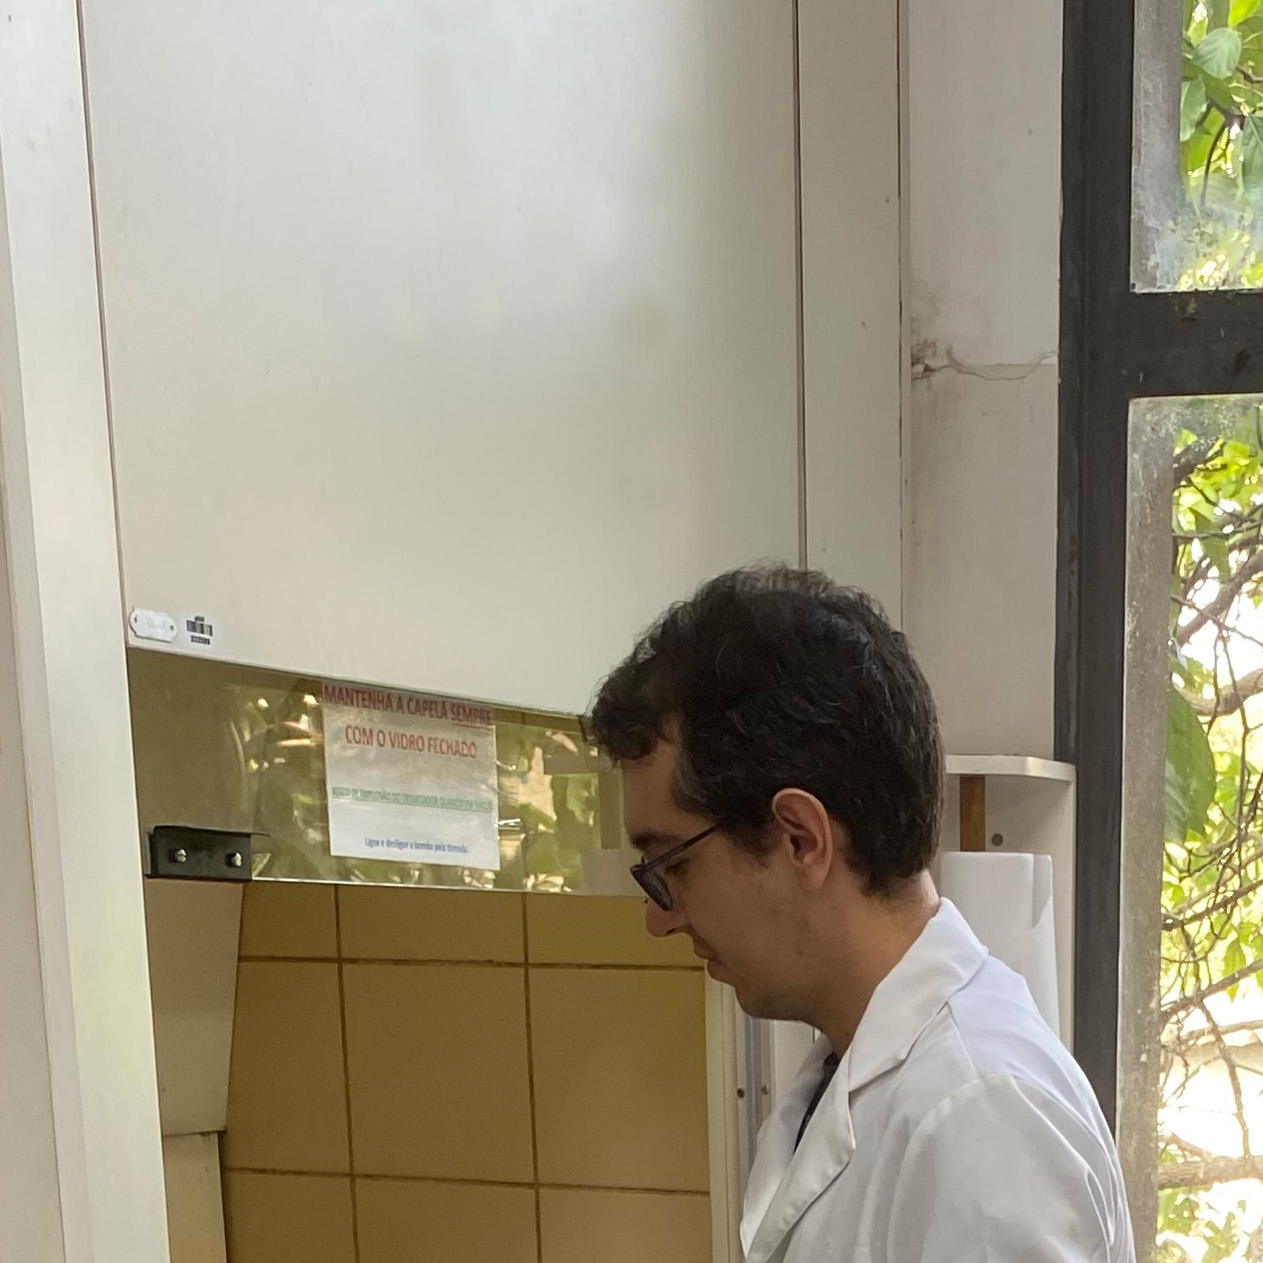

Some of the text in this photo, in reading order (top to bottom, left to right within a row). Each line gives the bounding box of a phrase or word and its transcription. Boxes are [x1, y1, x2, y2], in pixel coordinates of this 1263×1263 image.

[325, 685, 492, 726] MANTENHA A CAPELA SEMPRE
[345, 725, 477, 758] COM O VIDRO FECHADO
